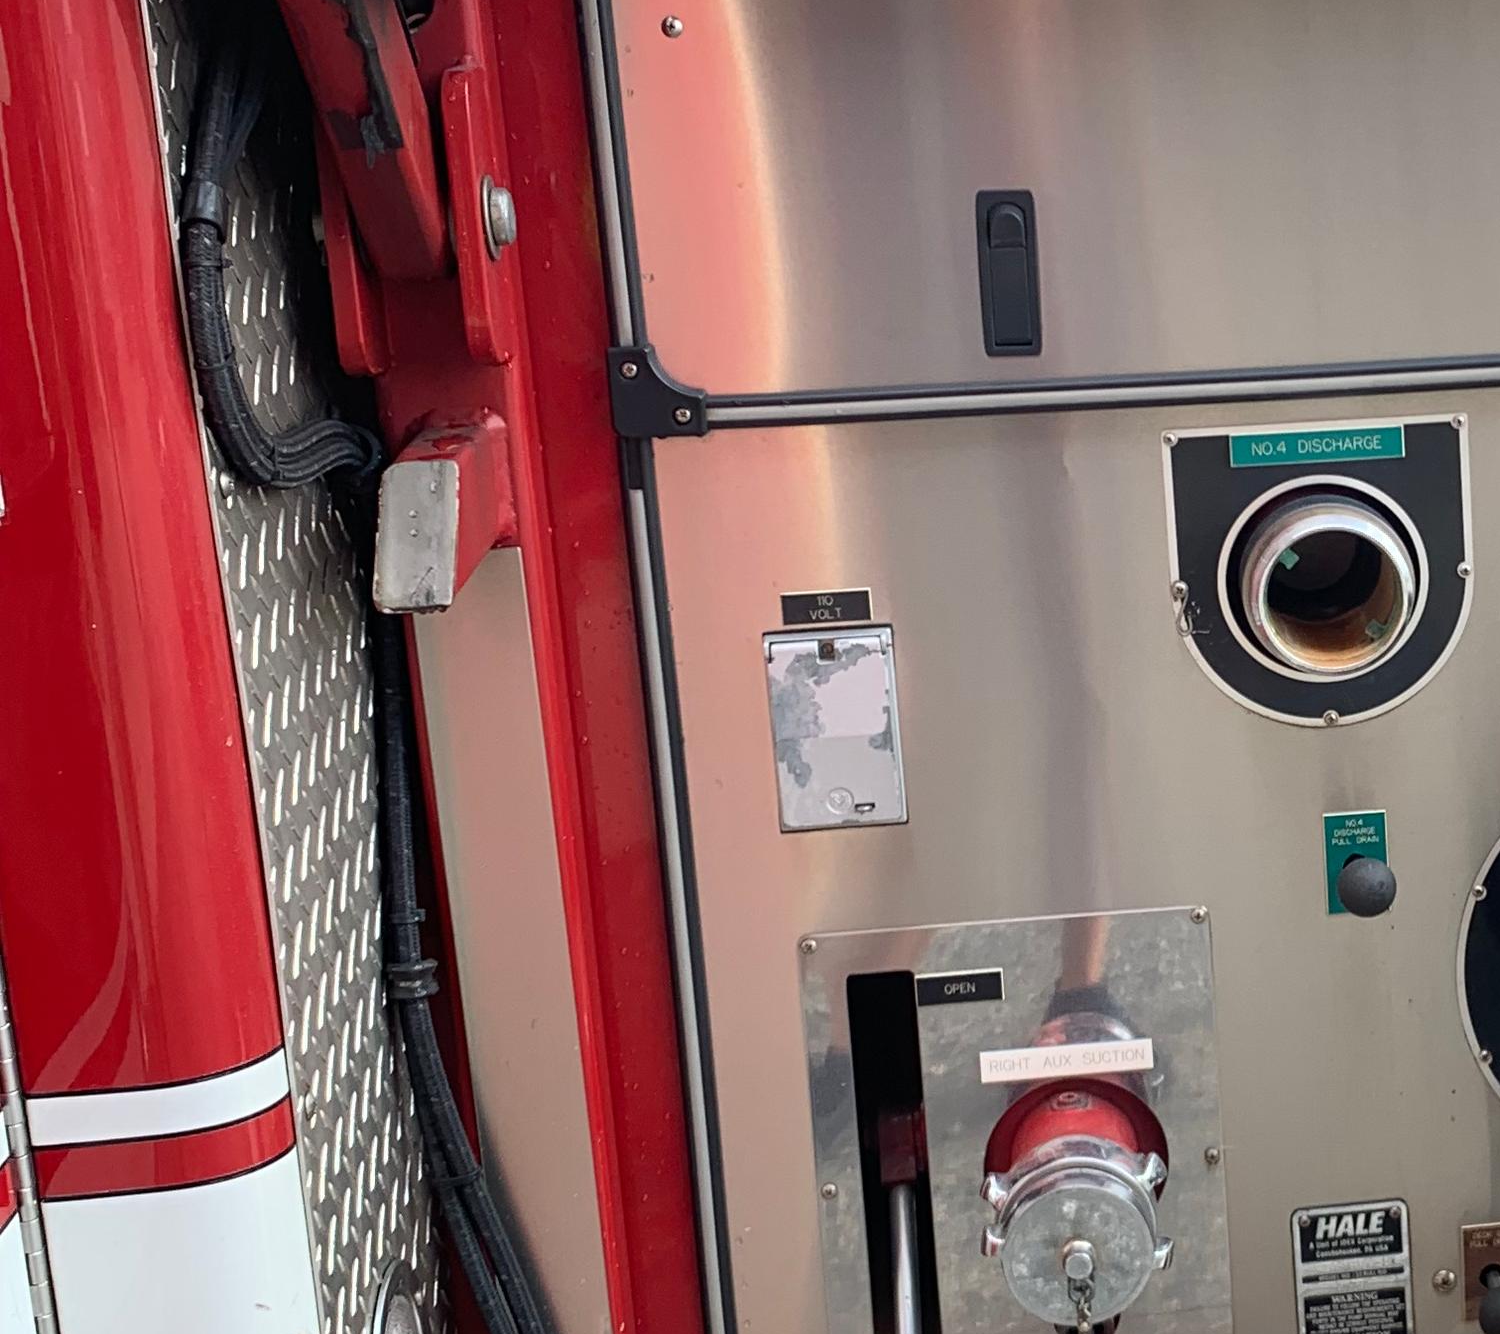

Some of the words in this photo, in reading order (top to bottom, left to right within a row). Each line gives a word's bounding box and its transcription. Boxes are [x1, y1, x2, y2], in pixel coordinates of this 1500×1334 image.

[1251, 441, 1287, 457] NO.4
[1298, 435, 1382, 453] DISCHARGE
[817, 595, 834, 606] 110
[810, 607, 842, 620] VOLT
[1334, 826, 1375, 837] DISCHARGE
[1332, 837, 1351, 845] PULL
[1356, 835, 1379, 844] DRAIN
[944, 982, 976, 995] OPEN
[988, 1056, 1031, 1074] RIGHT
[1042, 1052, 1072, 1069] AUX
[1082, 1048, 1146, 1066] SUCTION
[1315, 1211, 1386, 1240] HALE
[1331, 1291, 1379, 1303] WARNING
